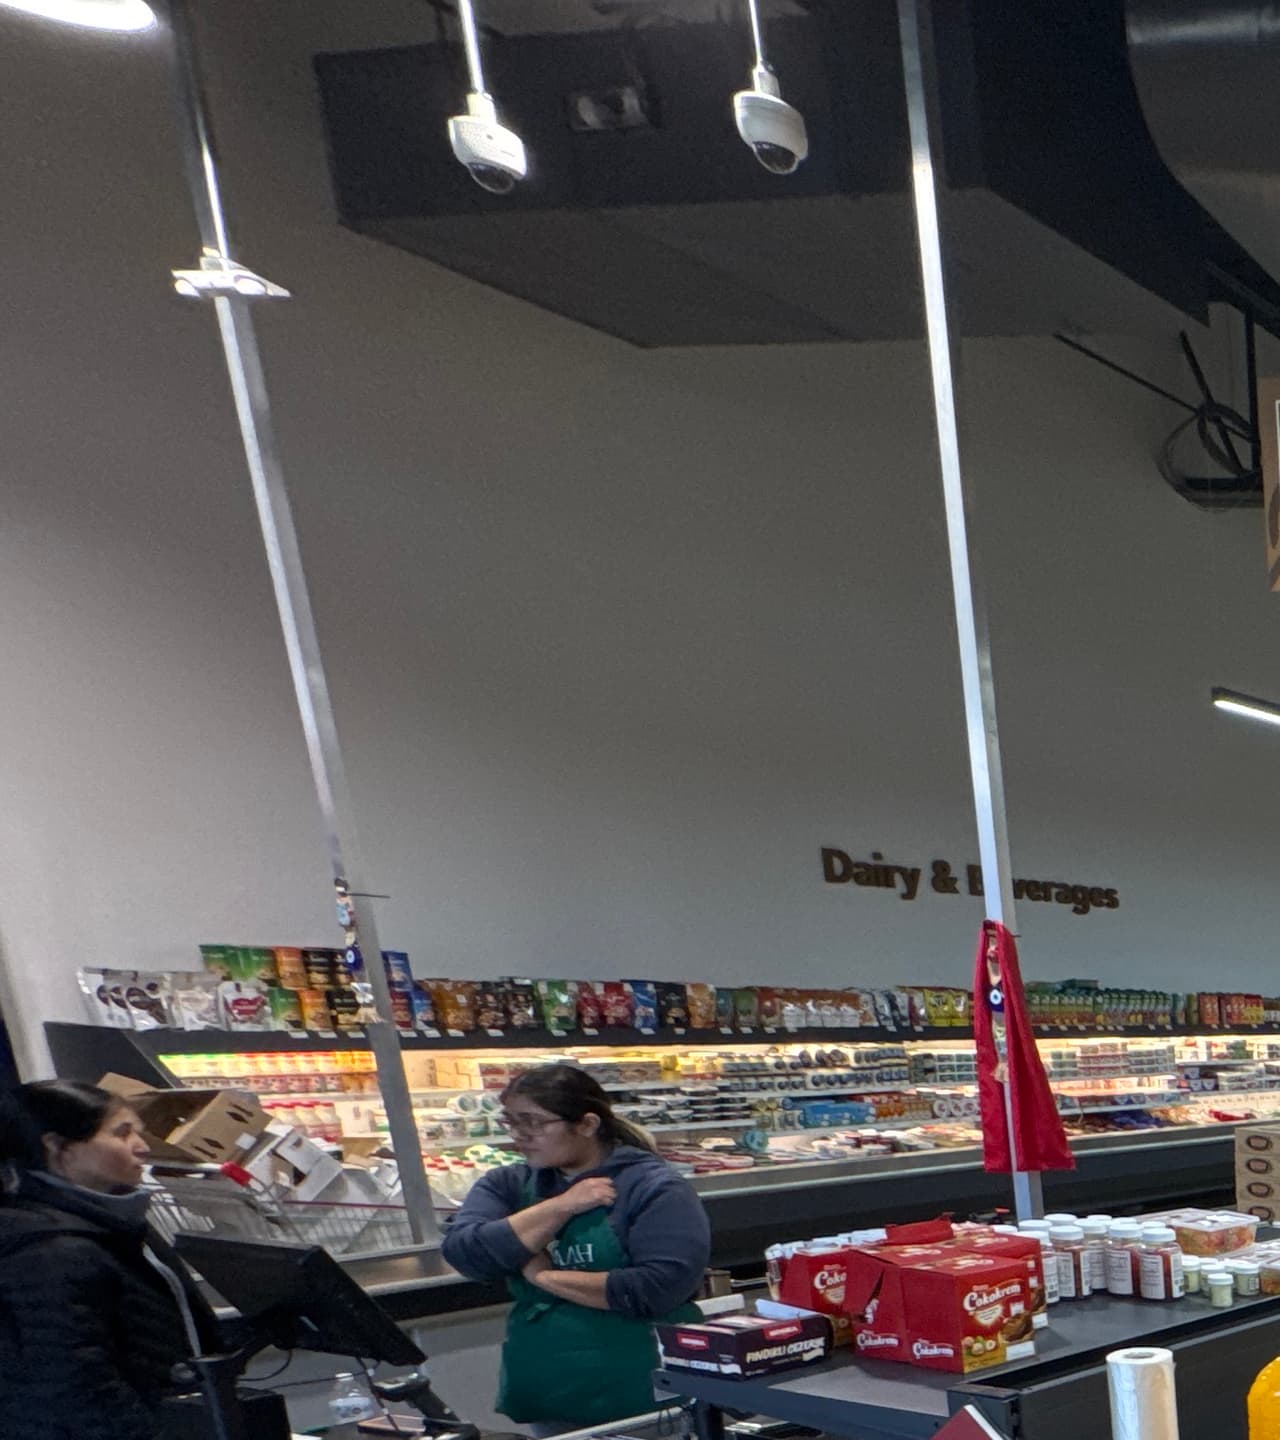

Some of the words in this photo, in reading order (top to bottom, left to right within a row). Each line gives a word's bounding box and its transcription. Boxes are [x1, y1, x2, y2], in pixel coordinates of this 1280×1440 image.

[821, 848, 921, 900] Dairy
[931, 860, 960, 894] &
[967, 864, 1120, 915] Bverages
